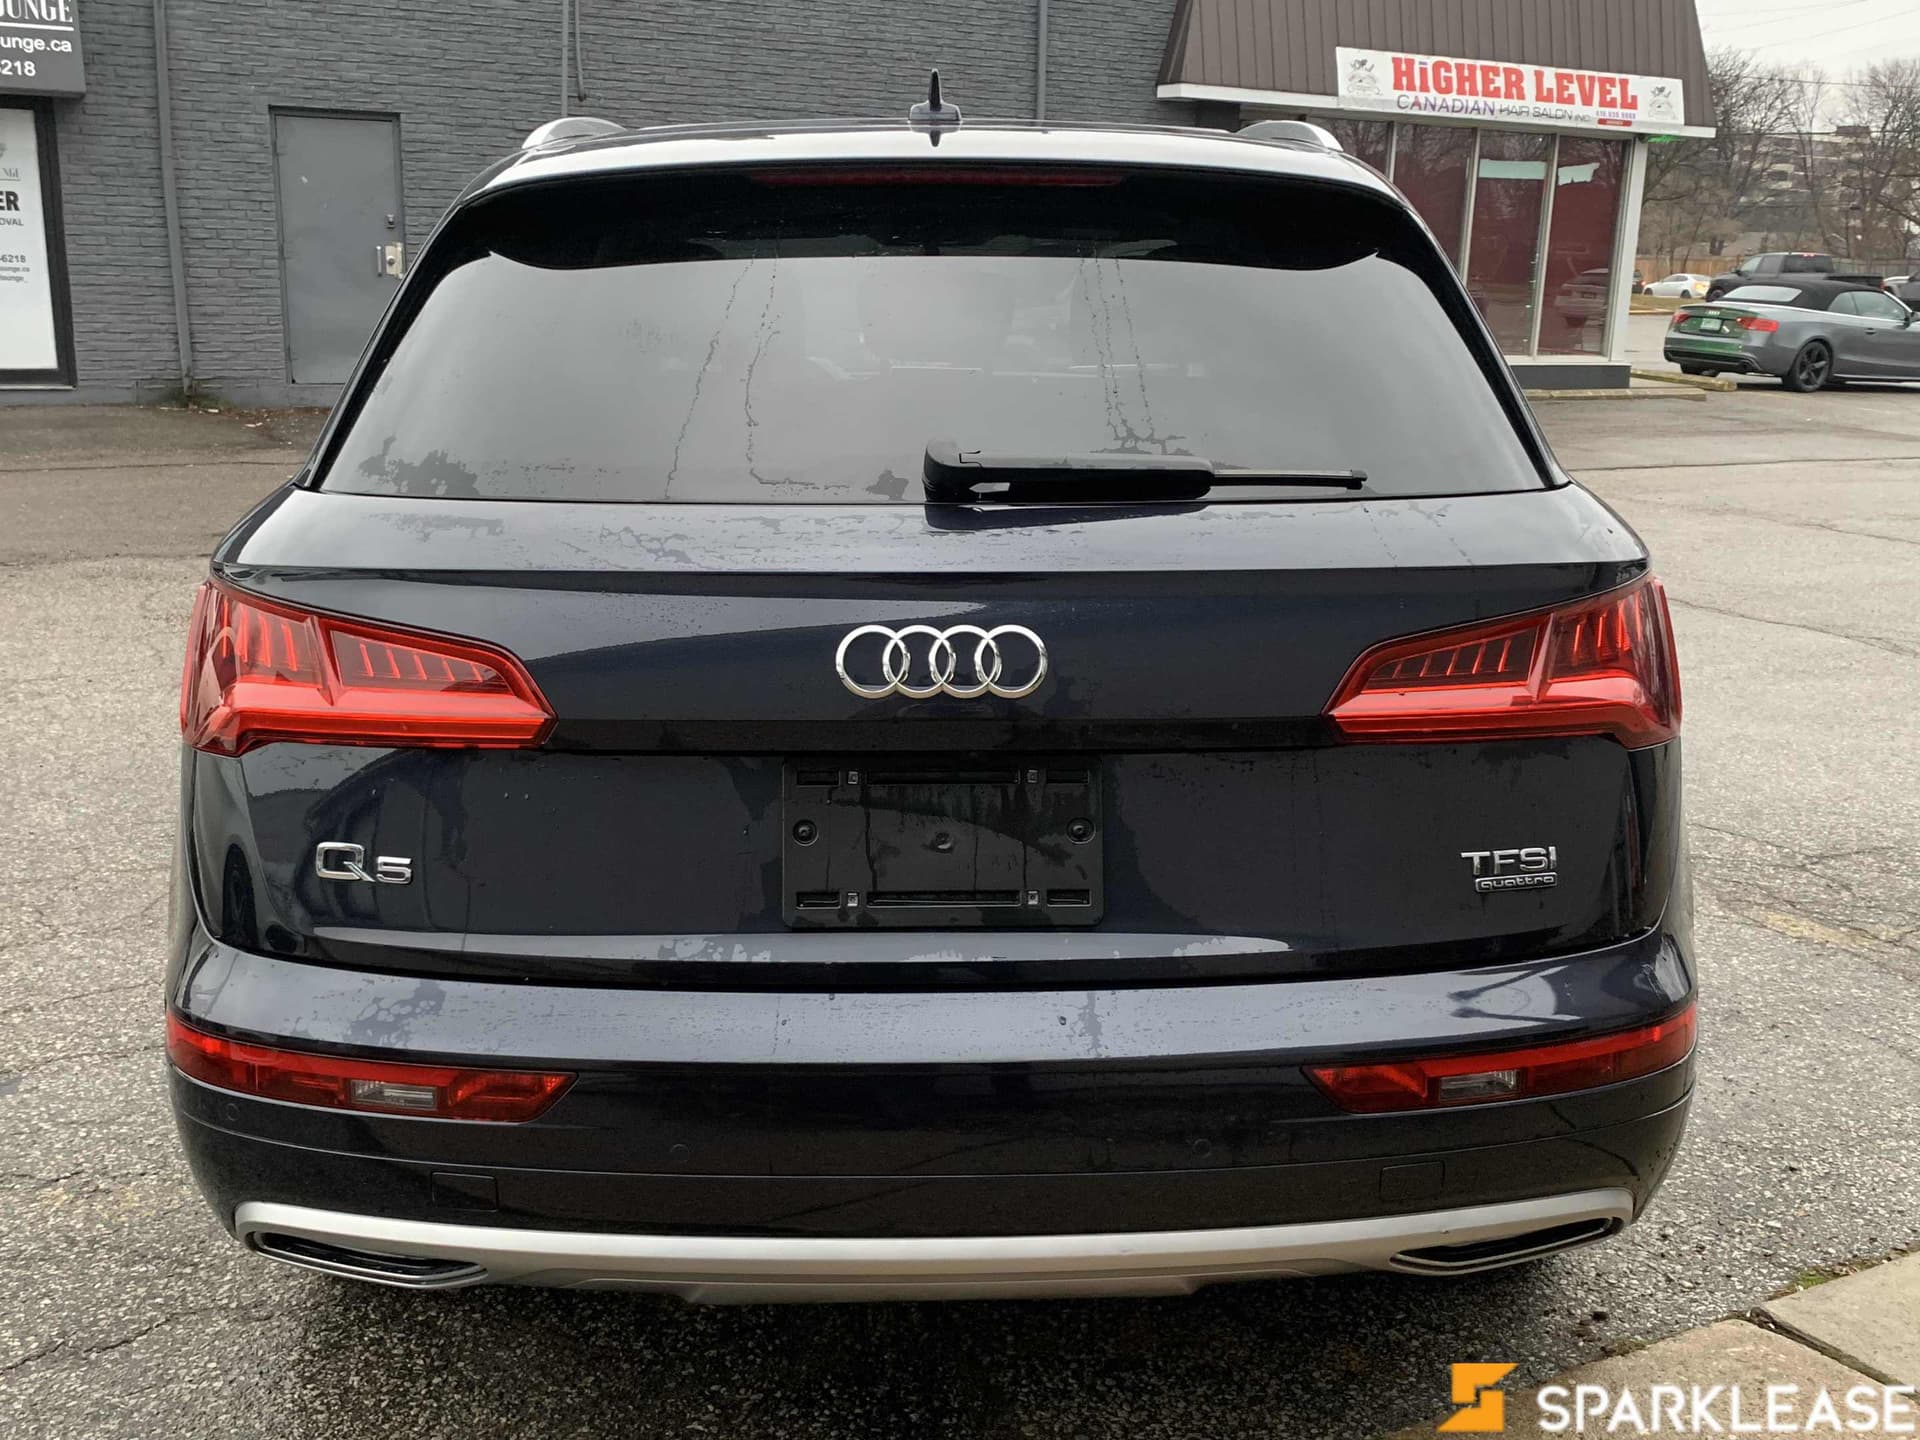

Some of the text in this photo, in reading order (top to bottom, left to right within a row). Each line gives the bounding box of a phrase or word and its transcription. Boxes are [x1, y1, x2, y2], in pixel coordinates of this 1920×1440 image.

[0, 36, 72, 53] unge.ca
[0, 60, 36, 76] 218
[1534, 70, 1638, 110] LEVEL
[1397, 94, 1495, 116] CANADIAN
[1500, 103, 1530, 116] HAIR
[1532, 106, 1573, 120] SALON
[316, 842, 412, 884] Q5
[1461, 846, 1557, 875] TFSI
[1481, 876, 1554, 891] quattro
